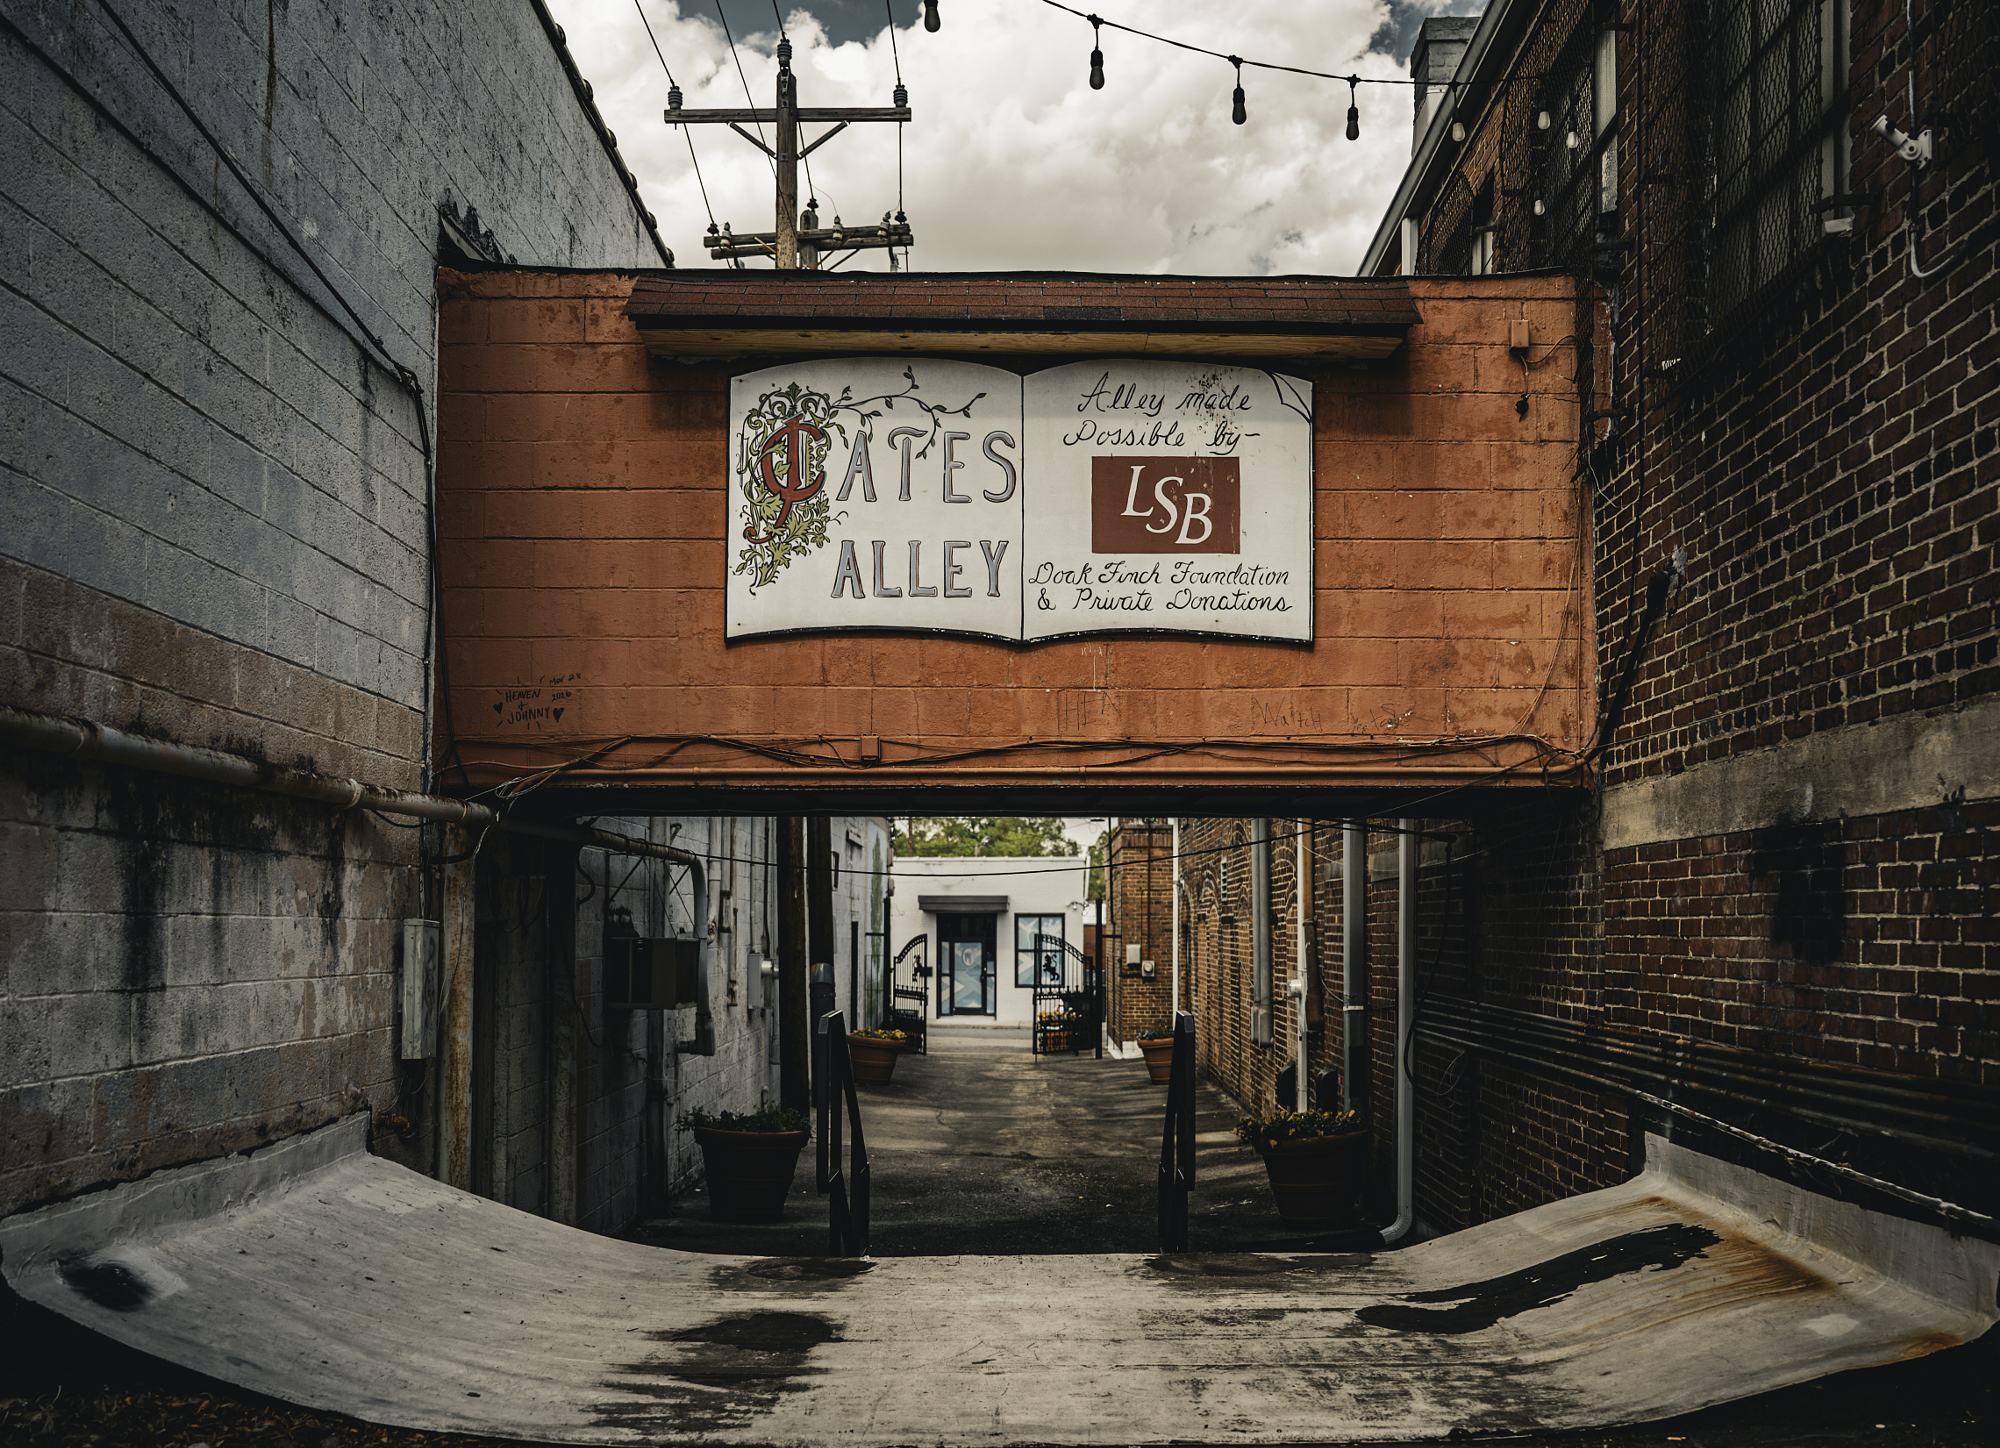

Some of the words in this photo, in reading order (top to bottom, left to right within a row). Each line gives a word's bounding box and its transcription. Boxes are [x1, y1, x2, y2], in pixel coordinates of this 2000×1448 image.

[1078, 371, 1165, 417] Alley
[1176, 385, 1252, 411] made
[1063, 420, 1185, 446] Possible
[1121, 465, 1213, 545] LSB
[831, 540, 1008, 599] ALLEY
[1029, 562, 1093, 585] Doak
[1098, 560, 1162, 586] Finch
[1171, 560, 1291, 586] Foundation
[1037, 588, 1056, 611] &
[1072, 587, 1153, 611] Private
[1166, 589, 1293, 612] Donations
[506, 689, 541, 702] HEAVEN
[507, 706, 550, 724] JOHNNY
